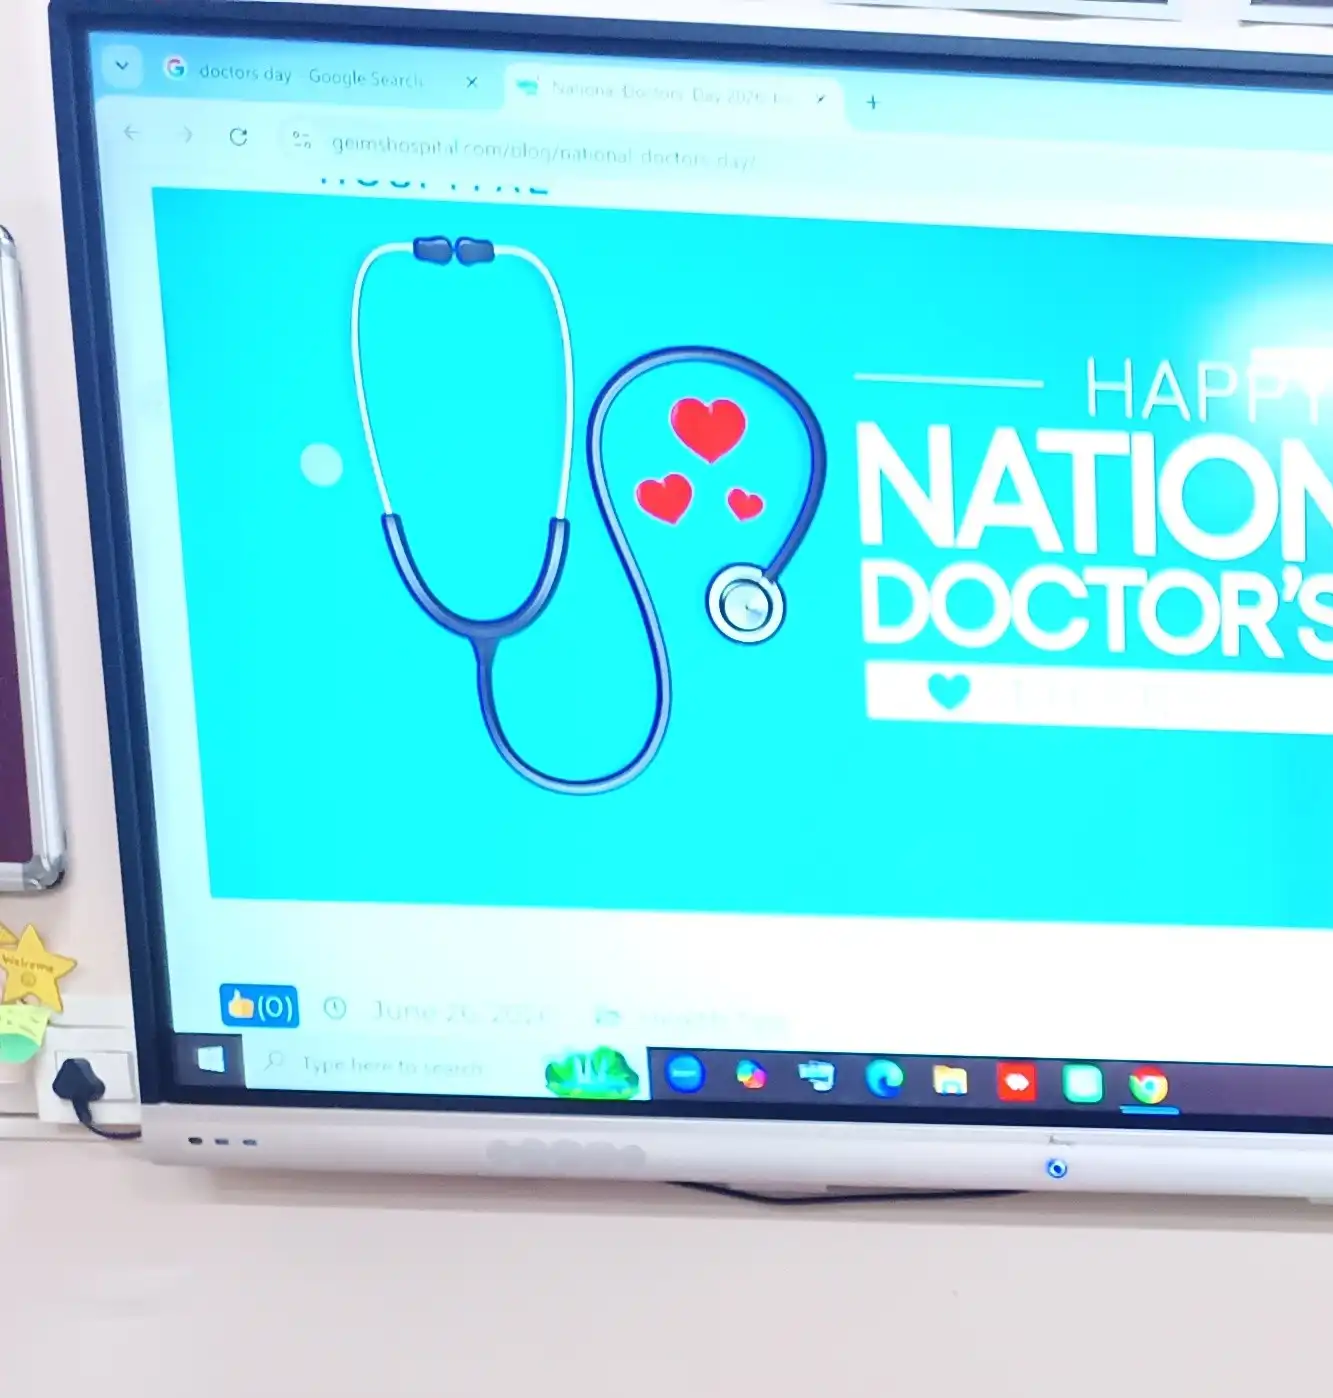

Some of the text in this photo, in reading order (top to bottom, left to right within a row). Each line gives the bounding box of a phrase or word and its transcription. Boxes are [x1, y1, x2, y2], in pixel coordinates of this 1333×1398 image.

[200, 64, 424, 89] doctors day Google Search
[1087, 356, 1329, 426] HAPPY
[304, 1056, 344, 1076] Type
